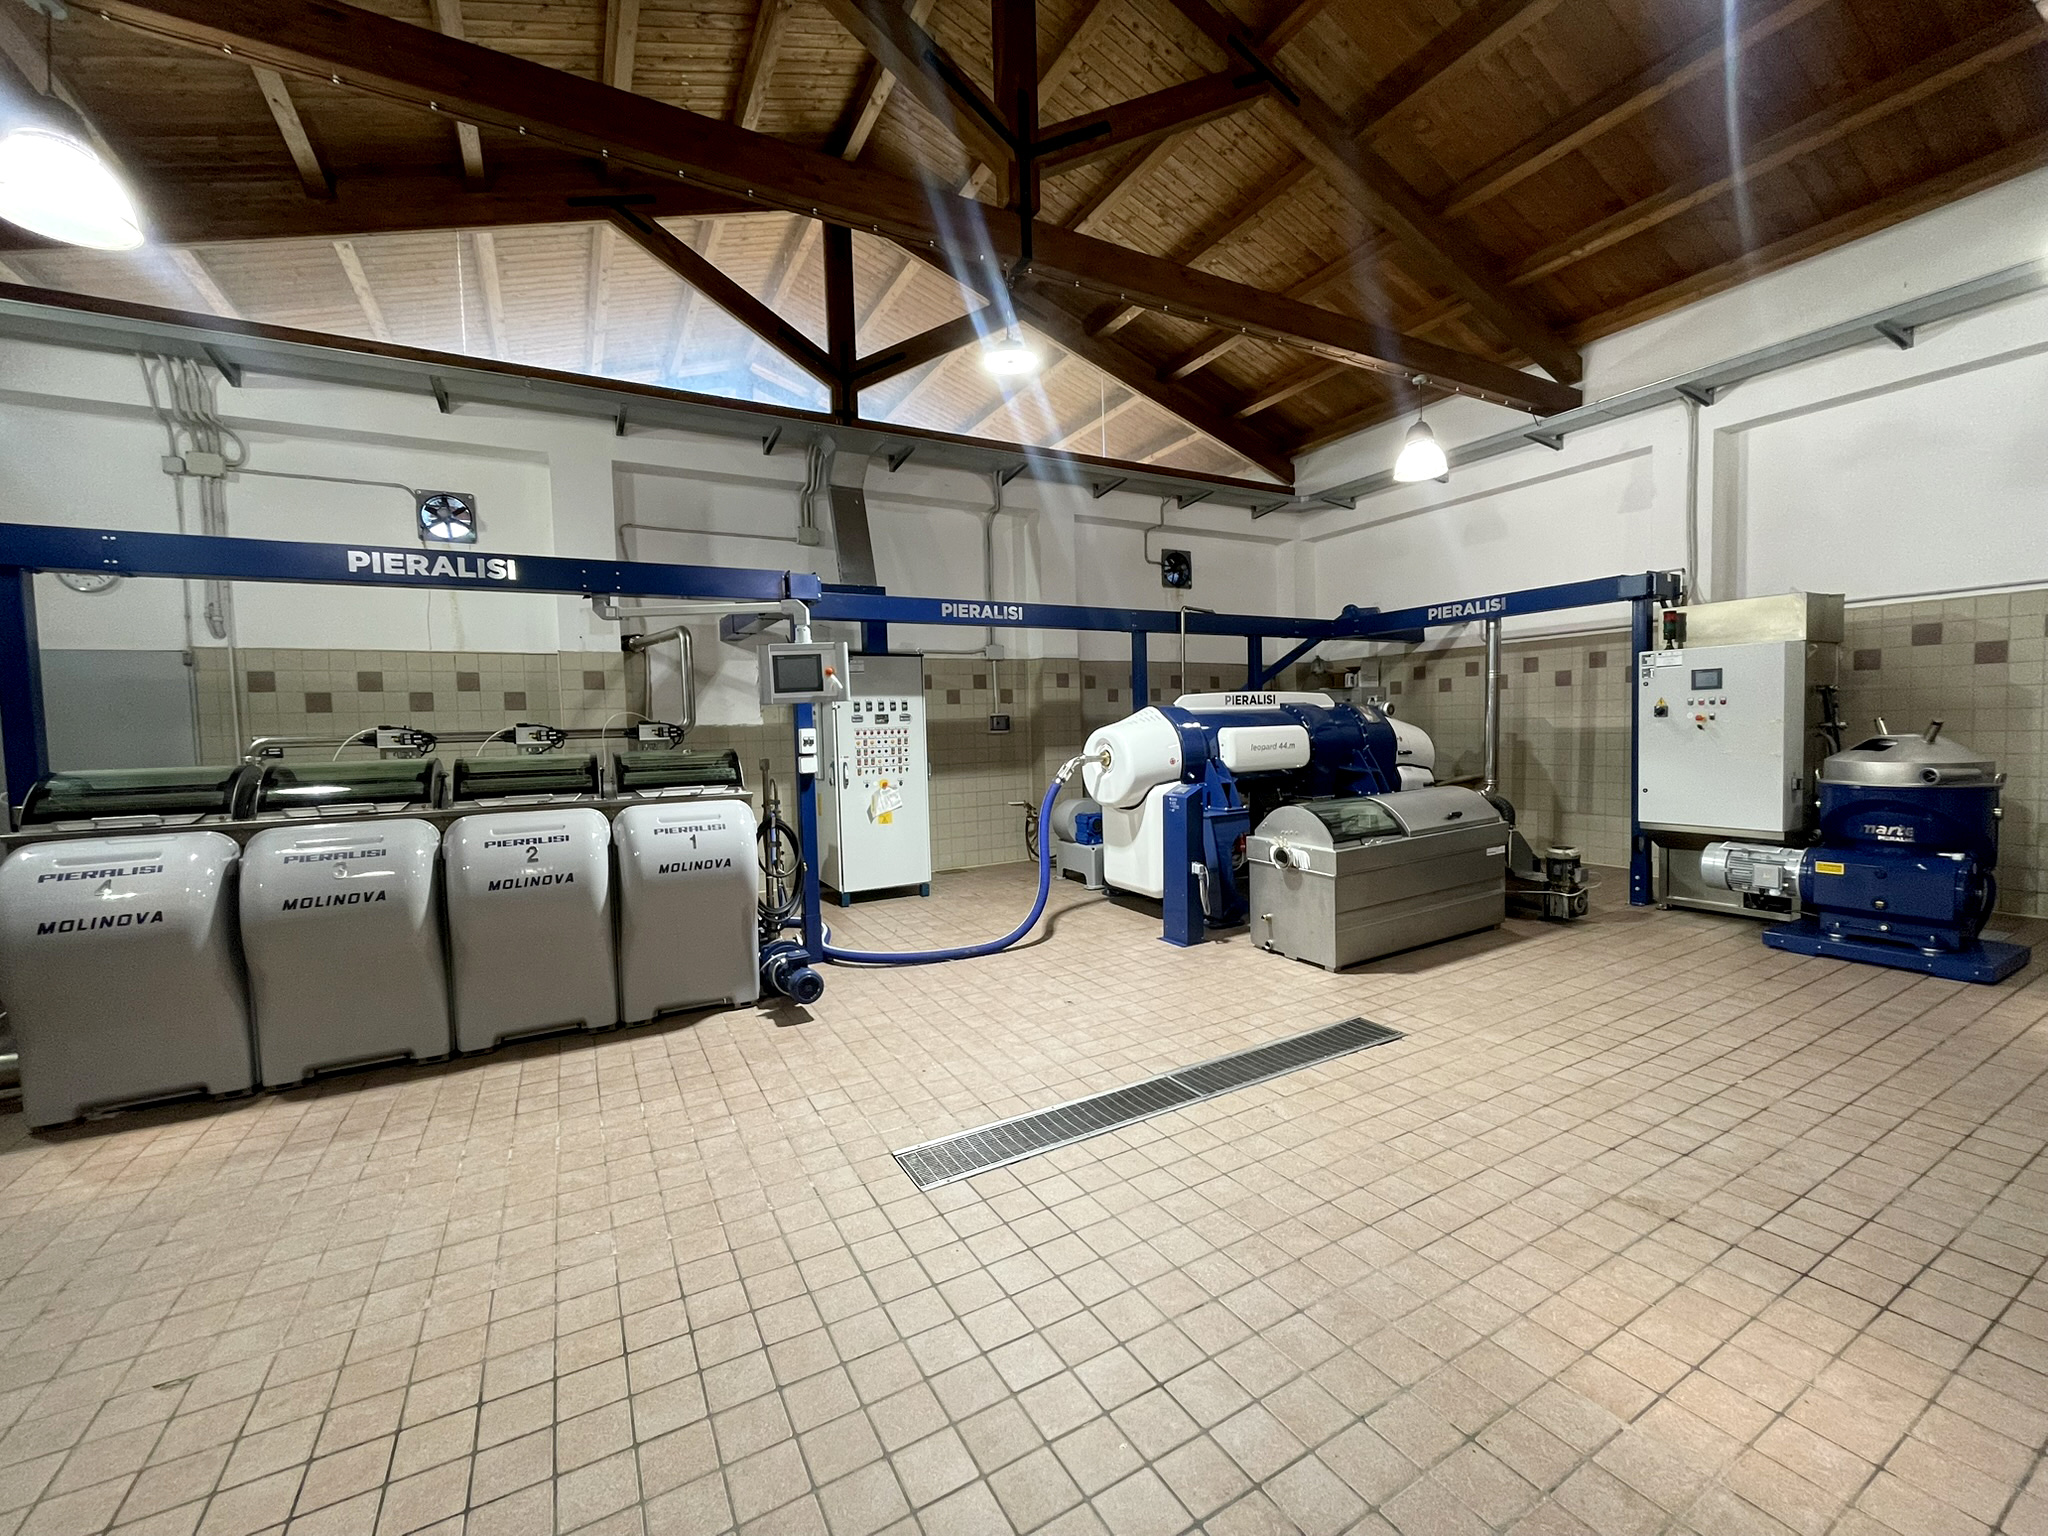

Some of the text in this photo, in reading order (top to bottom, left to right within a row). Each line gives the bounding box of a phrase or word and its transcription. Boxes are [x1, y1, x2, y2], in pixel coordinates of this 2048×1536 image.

[347, 550, 517, 581] PIERALISI
[941, 602, 1023, 620] PIERALISI
[1427, 597, 1506, 621] PIERALISI
[1225, 694, 1276, 706] PIERALISI
[1250, 743, 1277, 752] leopard
[653, 823, 726, 835] PIERALISI
[484, 835, 570, 849] PIERALISI
[689, 834, 697, 849] 1
[283, 849, 387, 864] PIERALISI
[525, 845, 539, 863] 2
[37, 864, 164, 884] PIERALISI
[333, 861, 348, 880] 3
[658, 858, 732, 875] MOLINOVA
[94, 878, 113, 900] 4
[488, 872, 575, 892] MOLINOVA
[282, 890, 387, 911] MOLINOVA
[37, 910, 164, 936] MOLINOVA
